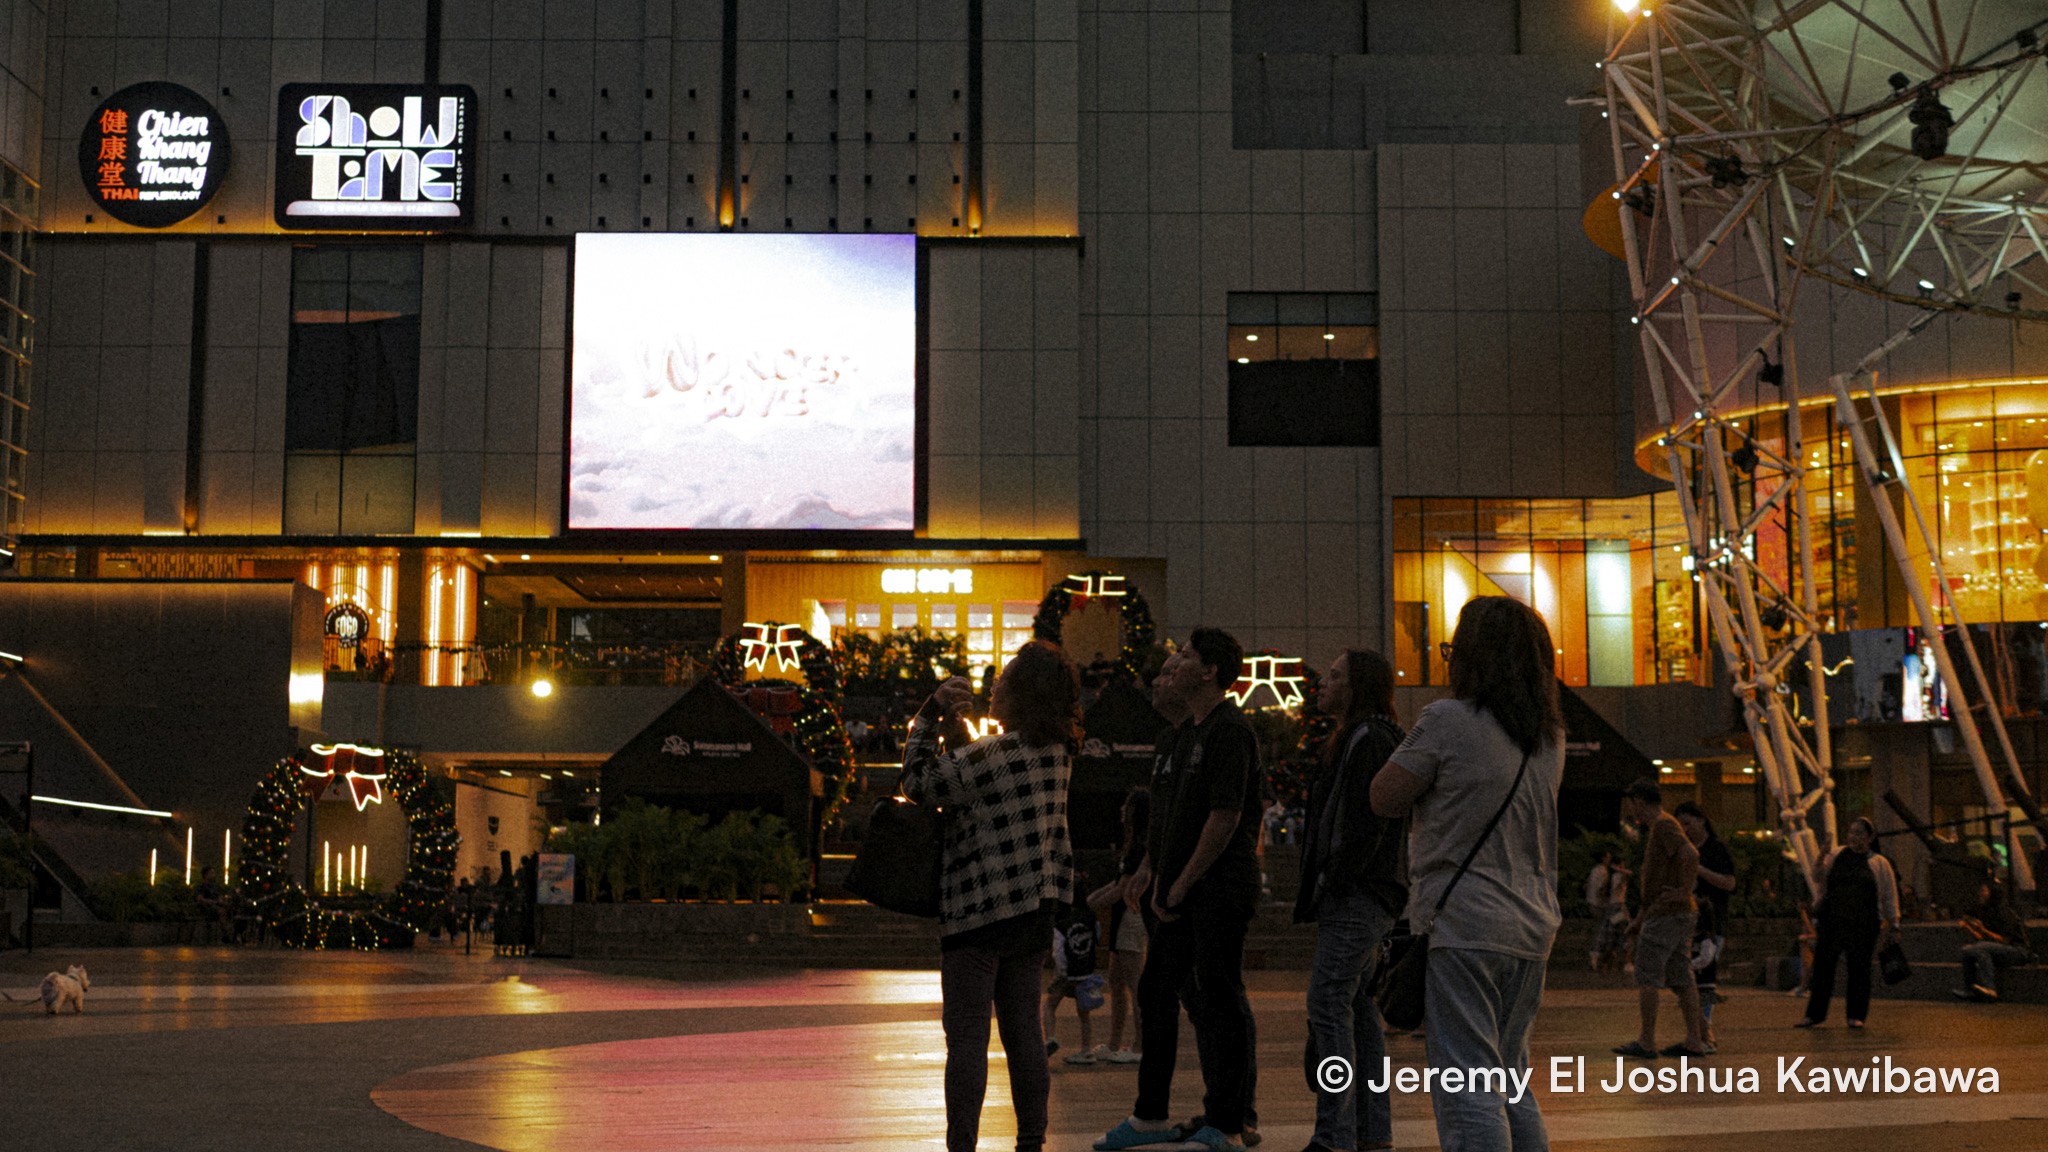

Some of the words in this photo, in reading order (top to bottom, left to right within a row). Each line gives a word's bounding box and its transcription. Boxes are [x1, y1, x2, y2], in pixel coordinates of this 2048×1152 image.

[137, 109, 209, 137] Chien
[457, 97, 465, 144] KARAOKE
[97, 108, 128, 186] 健康堂
[137, 136, 211, 166] Khang
[136, 160, 207, 190] Thang
[100, 188, 139, 201] THAI
